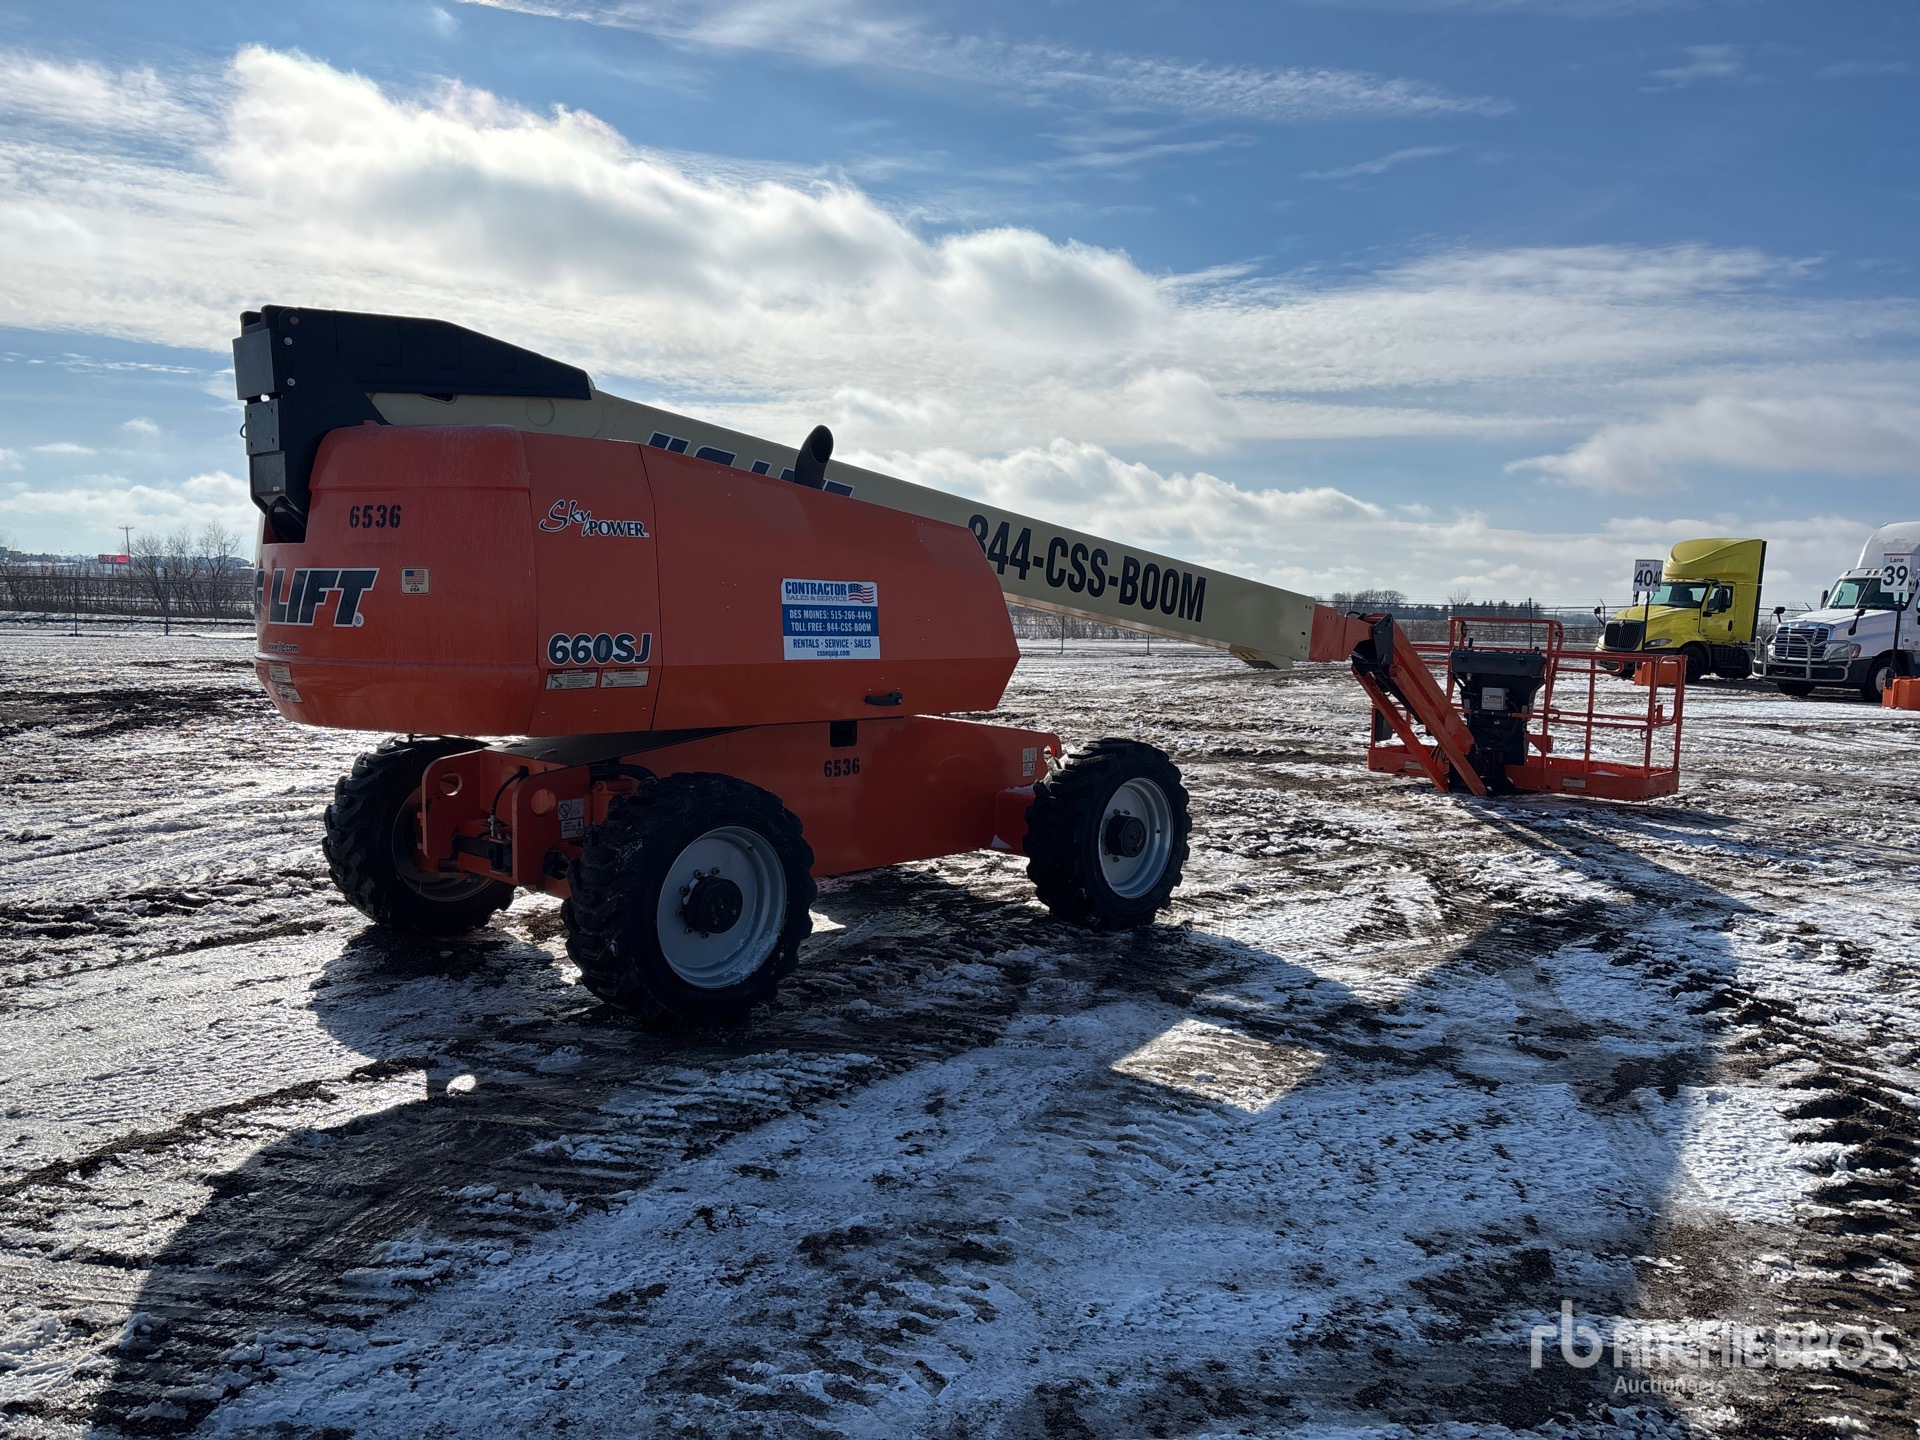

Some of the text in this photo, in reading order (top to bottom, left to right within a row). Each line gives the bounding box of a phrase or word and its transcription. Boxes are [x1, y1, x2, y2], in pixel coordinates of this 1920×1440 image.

[350, 504, 402, 529] 6536
[539, 499, 645, 538] Sky POWER
[1633, 569, 1653, 587] 40
[1882, 565, 1909, 587] 39
[268, 567, 381, 628] LIFT
[784, 581, 847, 596] CONTRACTOR
[789, 609, 872, 620] DES MOINES: 515-266-4449
[790, 622, 872, 632] TOLL FREE: 844-CSS-BOOM
[547, 632, 652, 665] 660SJ
[792, 638, 872, 649] RENTALS SERVICE SALES
[816, 649, 851, 658] cssequip.com
[824, 757, 860, 777] 6536
